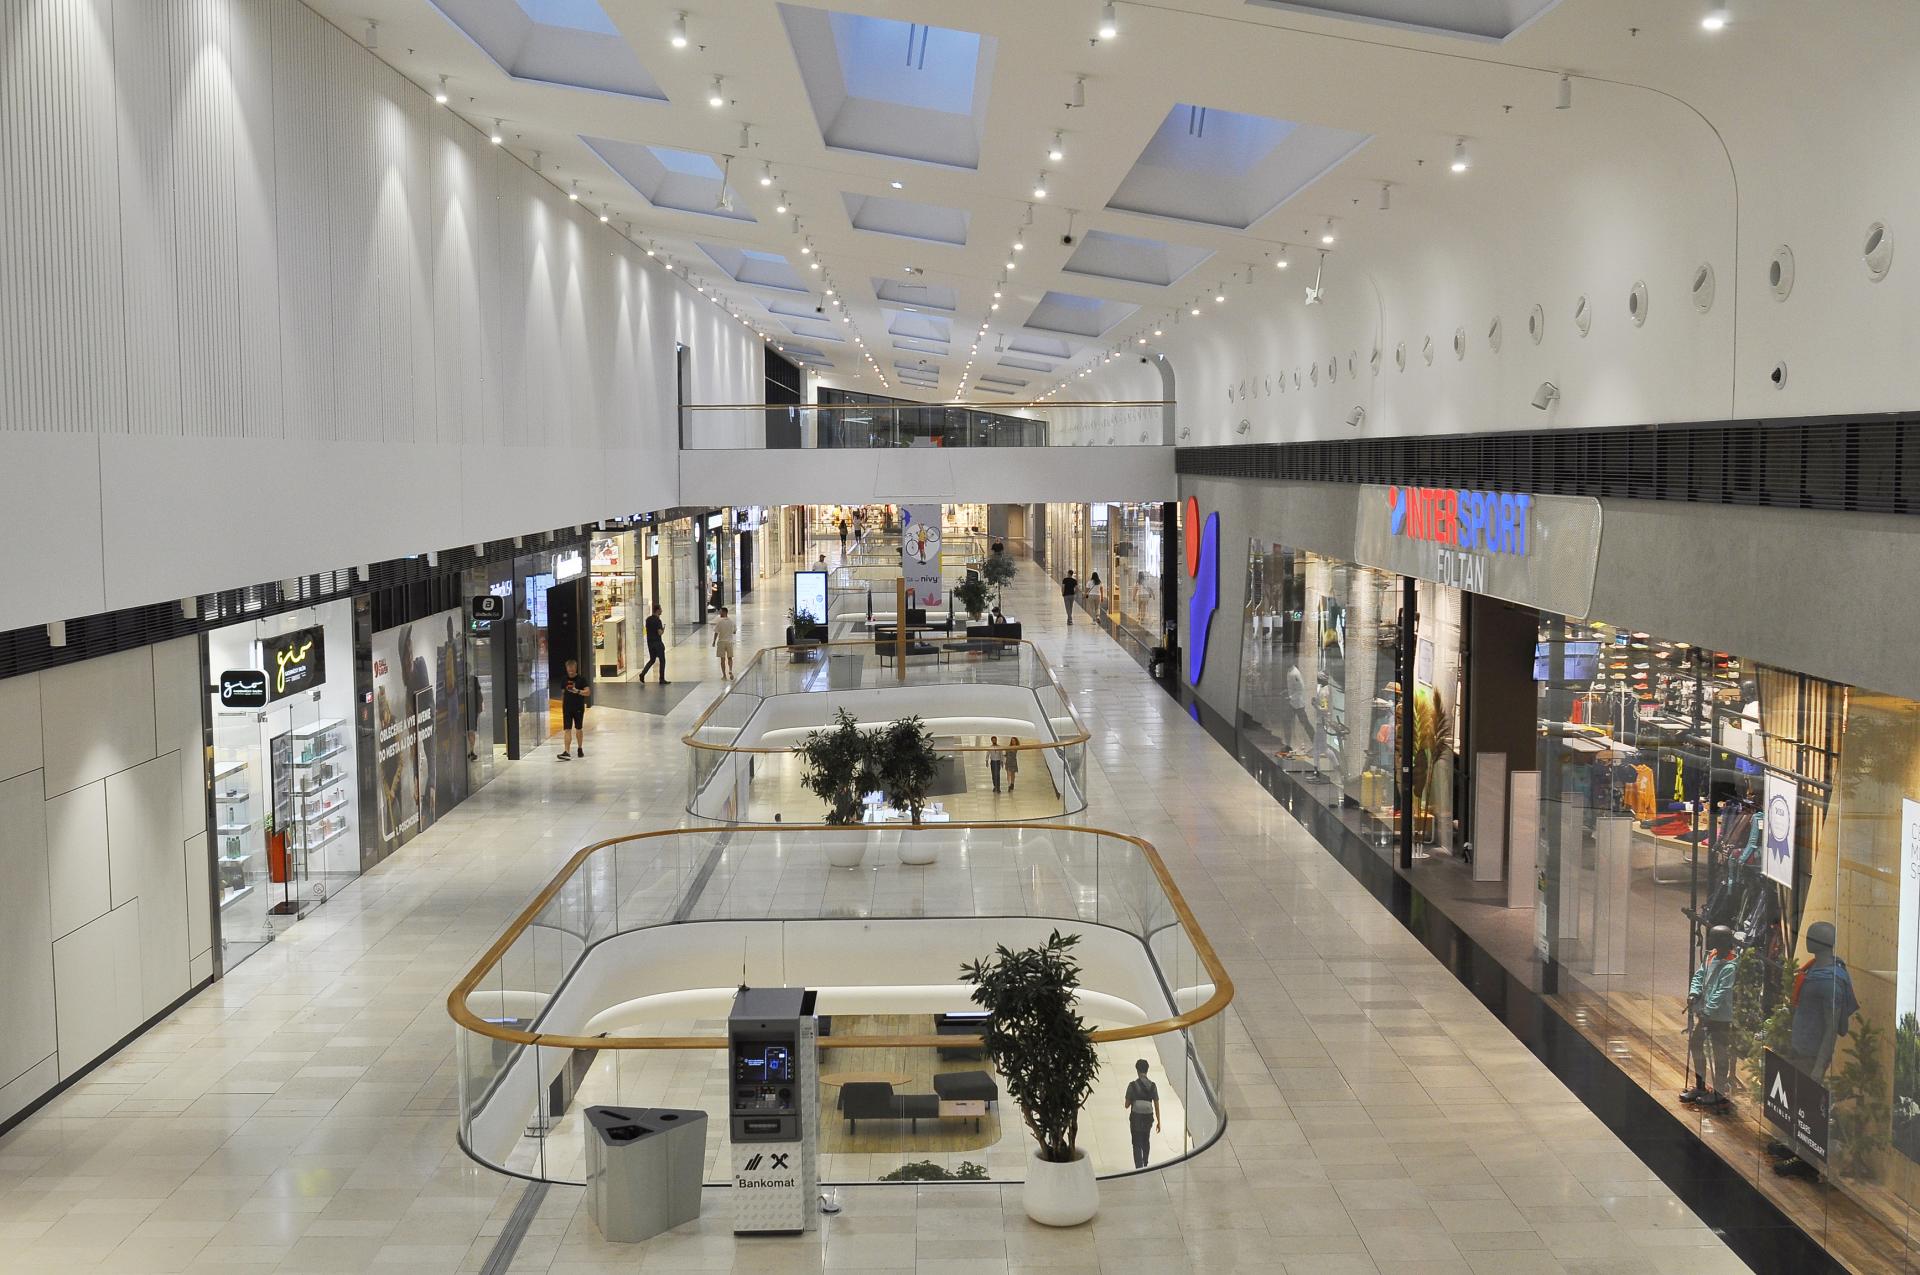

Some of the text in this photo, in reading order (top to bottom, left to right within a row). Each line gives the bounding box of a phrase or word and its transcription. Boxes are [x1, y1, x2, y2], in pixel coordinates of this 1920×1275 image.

[1405, 486, 1531, 556] INTERSPORT
[1437, 549, 1486, 594] FOLTAN
[277, 641, 312, 693] gio
[223, 681, 263, 698] gio
[1797, 1119, 1811, 1135] YEARS
[739, 1178, 795, 1188] Bankomat
